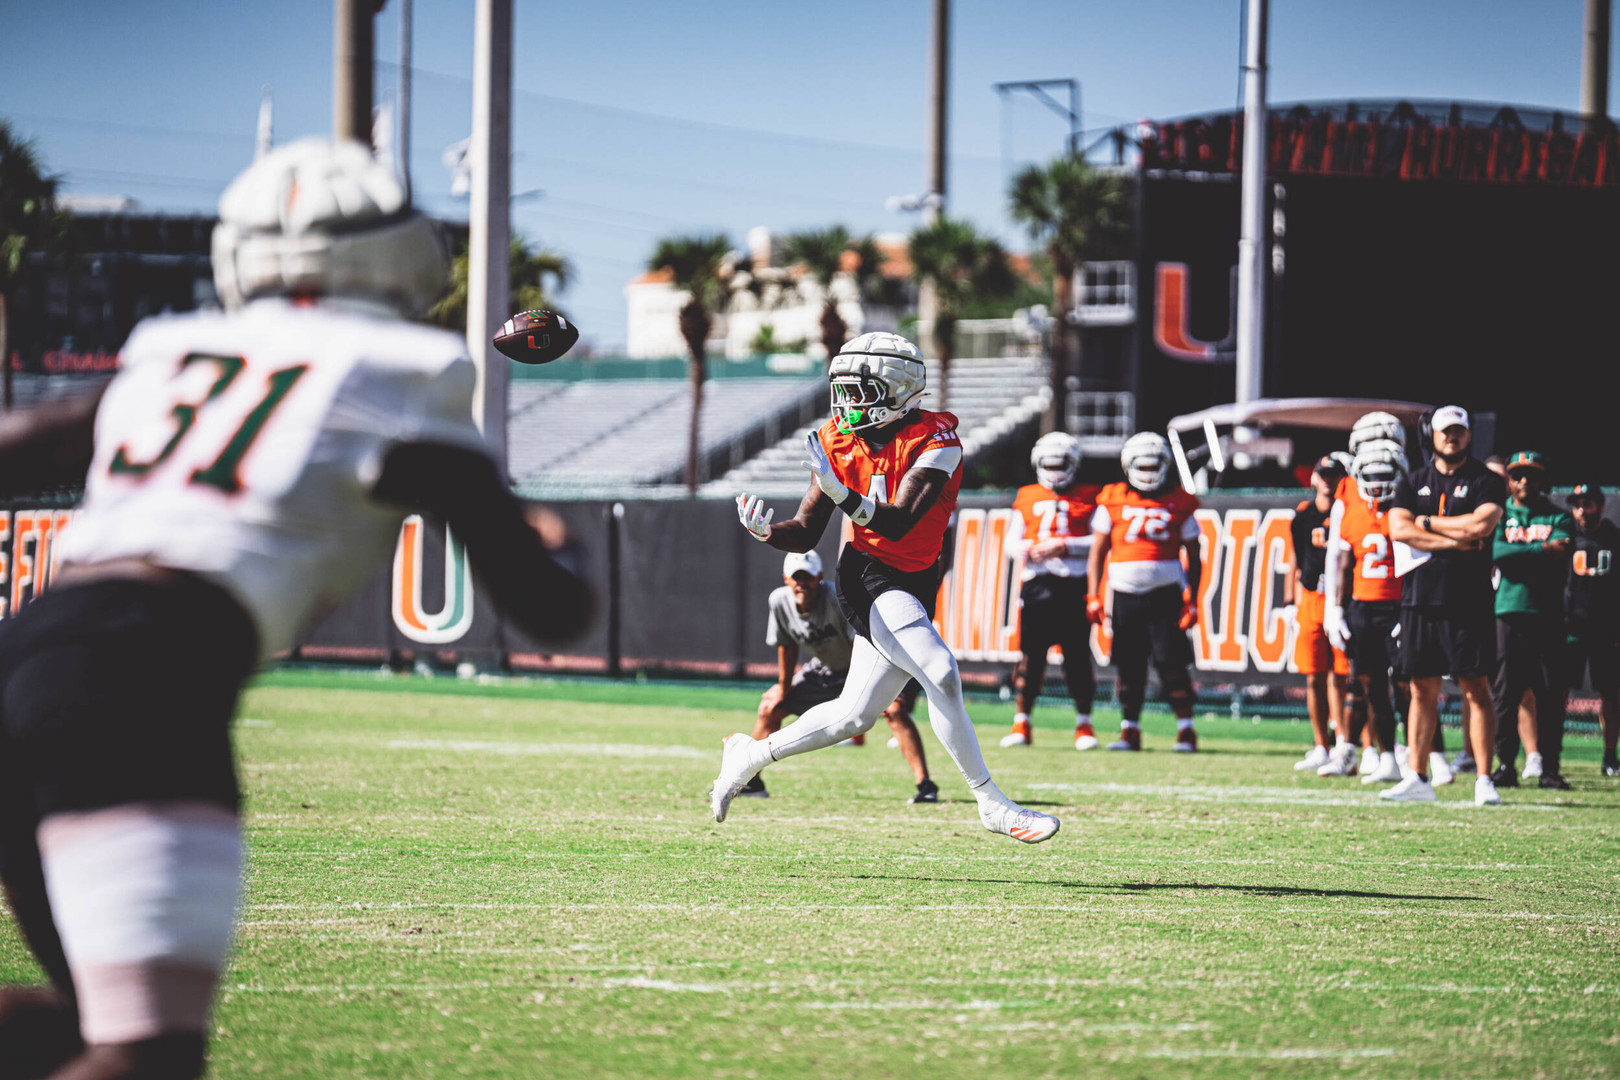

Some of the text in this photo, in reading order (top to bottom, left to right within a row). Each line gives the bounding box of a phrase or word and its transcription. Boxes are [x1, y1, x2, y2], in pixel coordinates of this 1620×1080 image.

[527, 333, 550, 350] U
[106, 350, 310, 495] 31
[1032, 499, 1070, 541] 71
[1122, 505, 1172, 542] 72
[1361, 533, 1388, 579] 2
[1573, 550, 1612, 575] U
[391, 514, 474, 644] U
